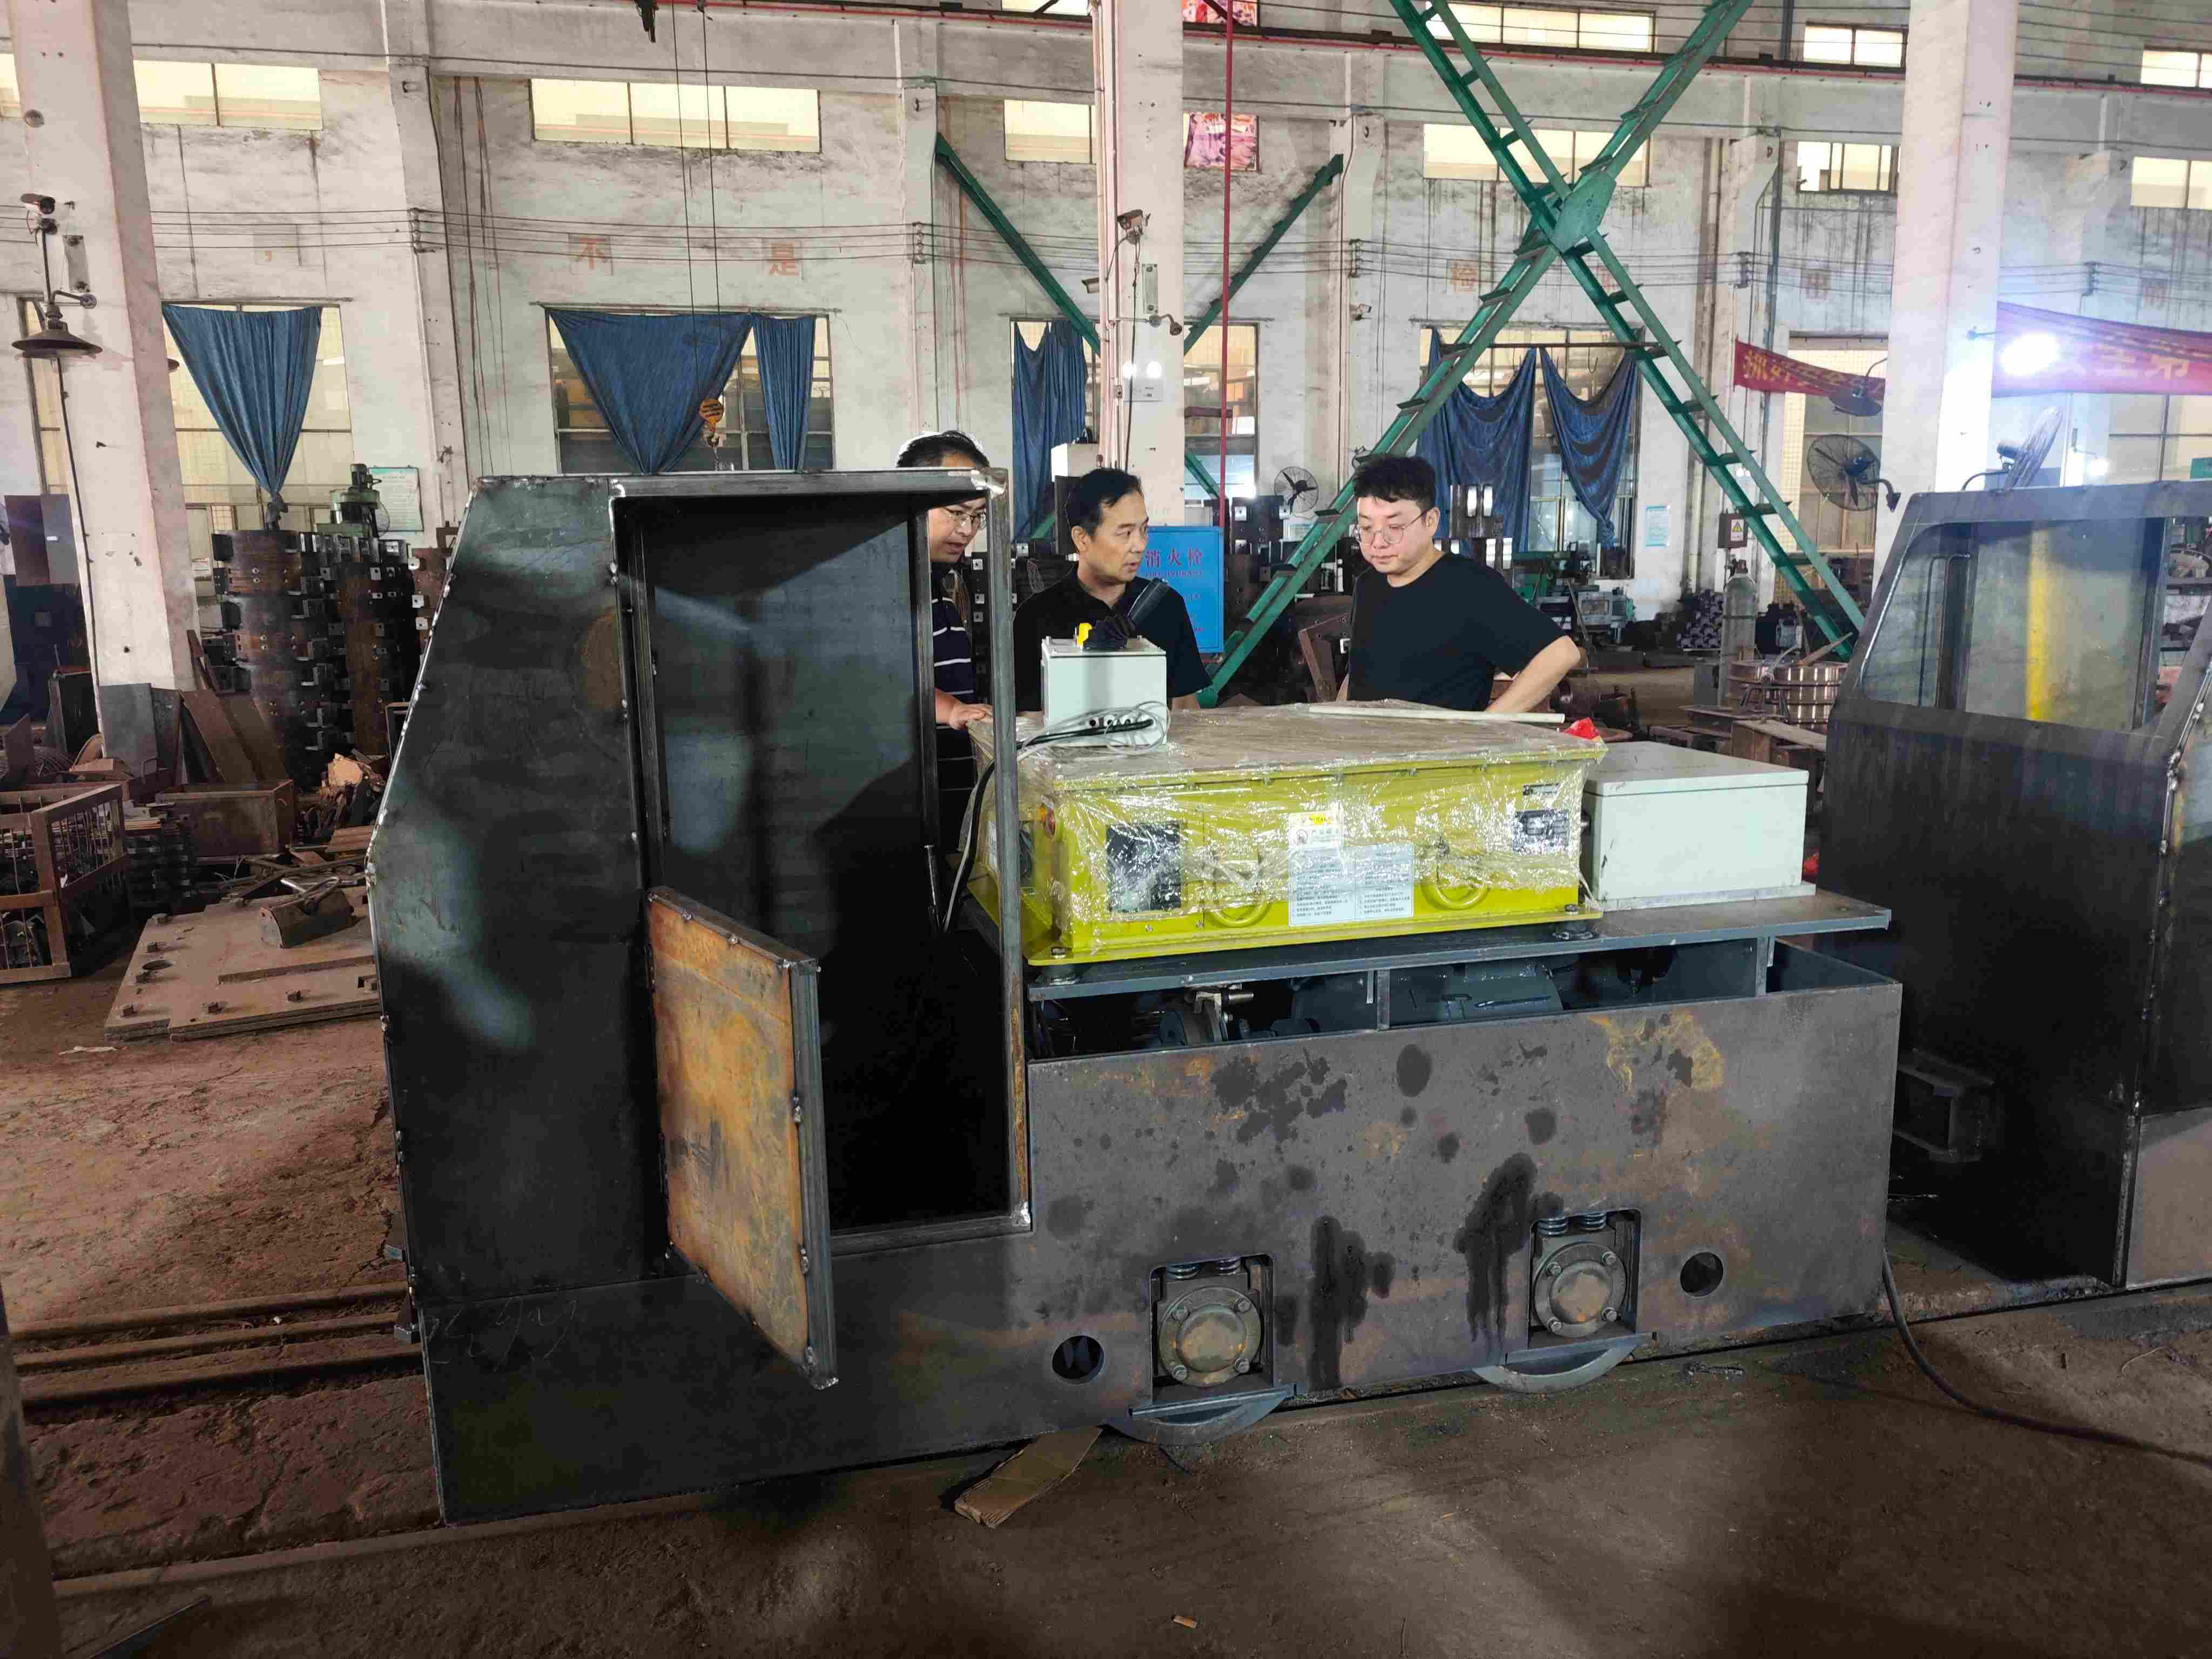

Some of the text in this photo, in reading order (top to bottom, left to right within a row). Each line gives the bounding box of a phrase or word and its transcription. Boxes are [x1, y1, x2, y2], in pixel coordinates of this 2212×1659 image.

[768, 241, 799, 276] 是
[1145, 548, 1203, 567] 消火栓
